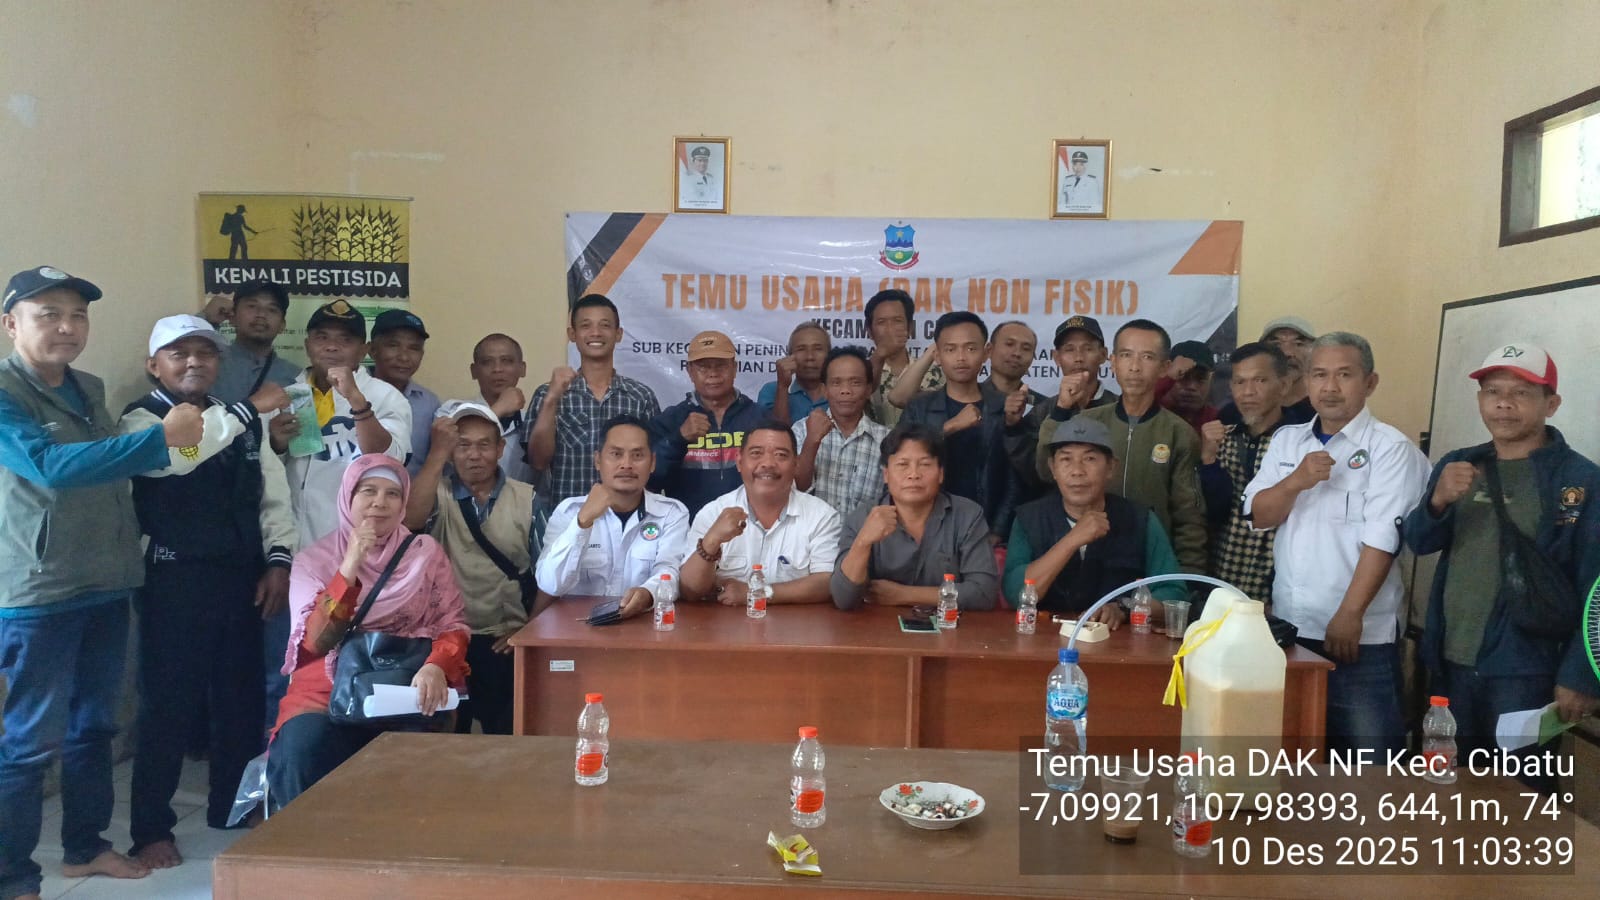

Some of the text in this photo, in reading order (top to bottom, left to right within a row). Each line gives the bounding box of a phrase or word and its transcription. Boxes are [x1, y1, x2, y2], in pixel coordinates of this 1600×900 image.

[214, 267, 402, 288] KENALI PESTISIDA
[661, 273, 748, 311] TEMU
[761, 274, 864, 313] USAHA
[967, 277, 1031, 315] NON
[1044, 278, 1139, 316] FISIK)
[632, 341, 662, 354] SUB
[1053, 698, 1080, 710] AQUA
